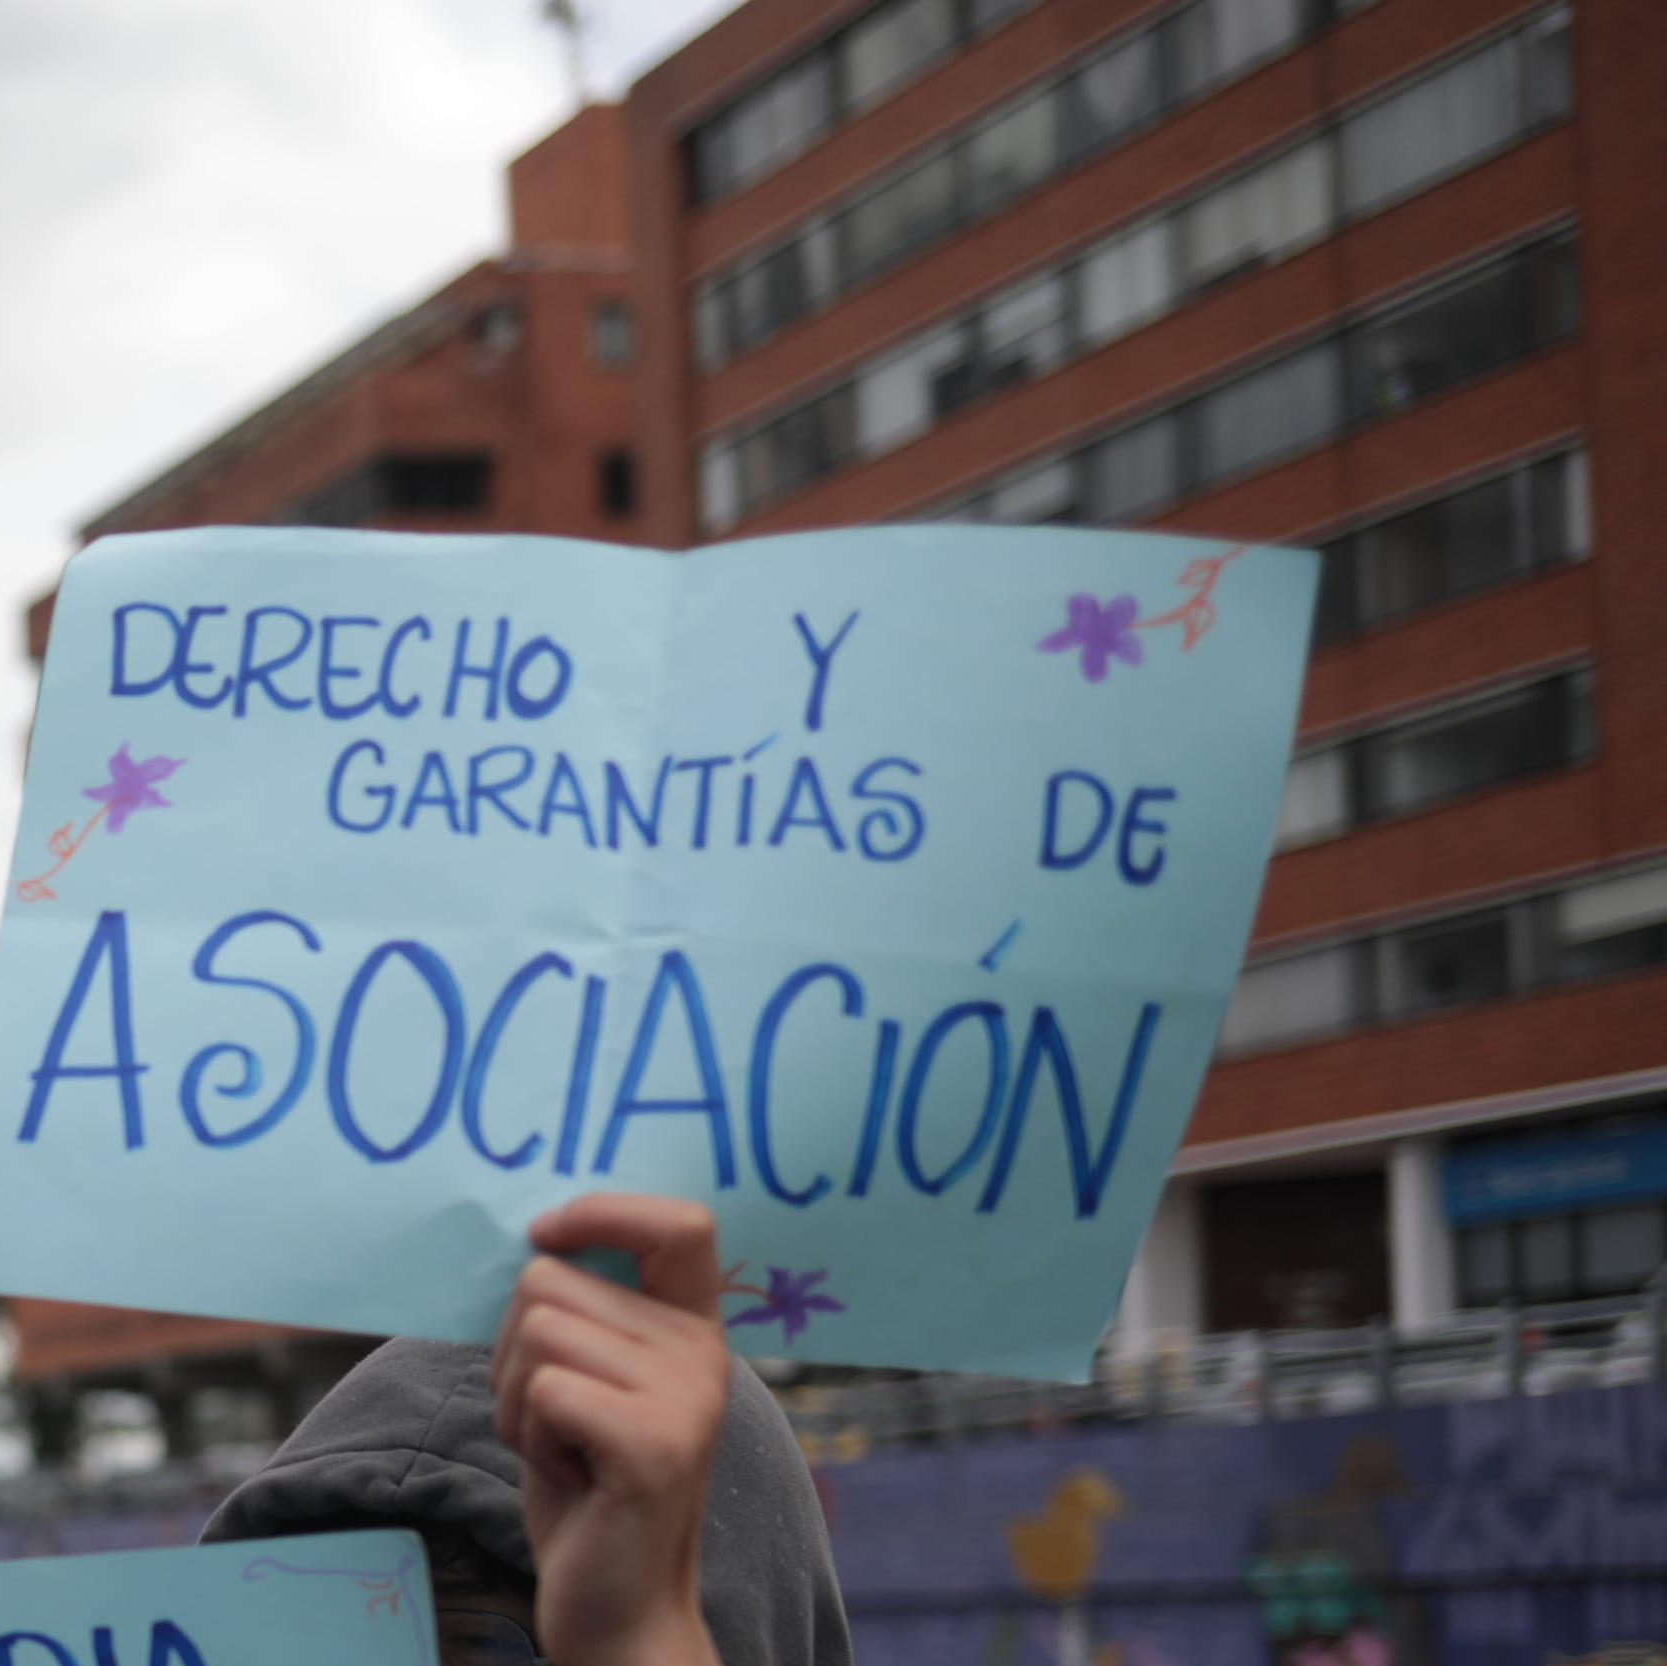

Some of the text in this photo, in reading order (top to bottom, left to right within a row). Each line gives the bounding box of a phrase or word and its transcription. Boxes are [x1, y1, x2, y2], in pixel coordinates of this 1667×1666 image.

[108, 603, 861, 732] DERECHO Y
[325, 731, 1180, 887] GARANTÍAS DE
[15, 909, 1163, 1220] ASOCIACIÓN
